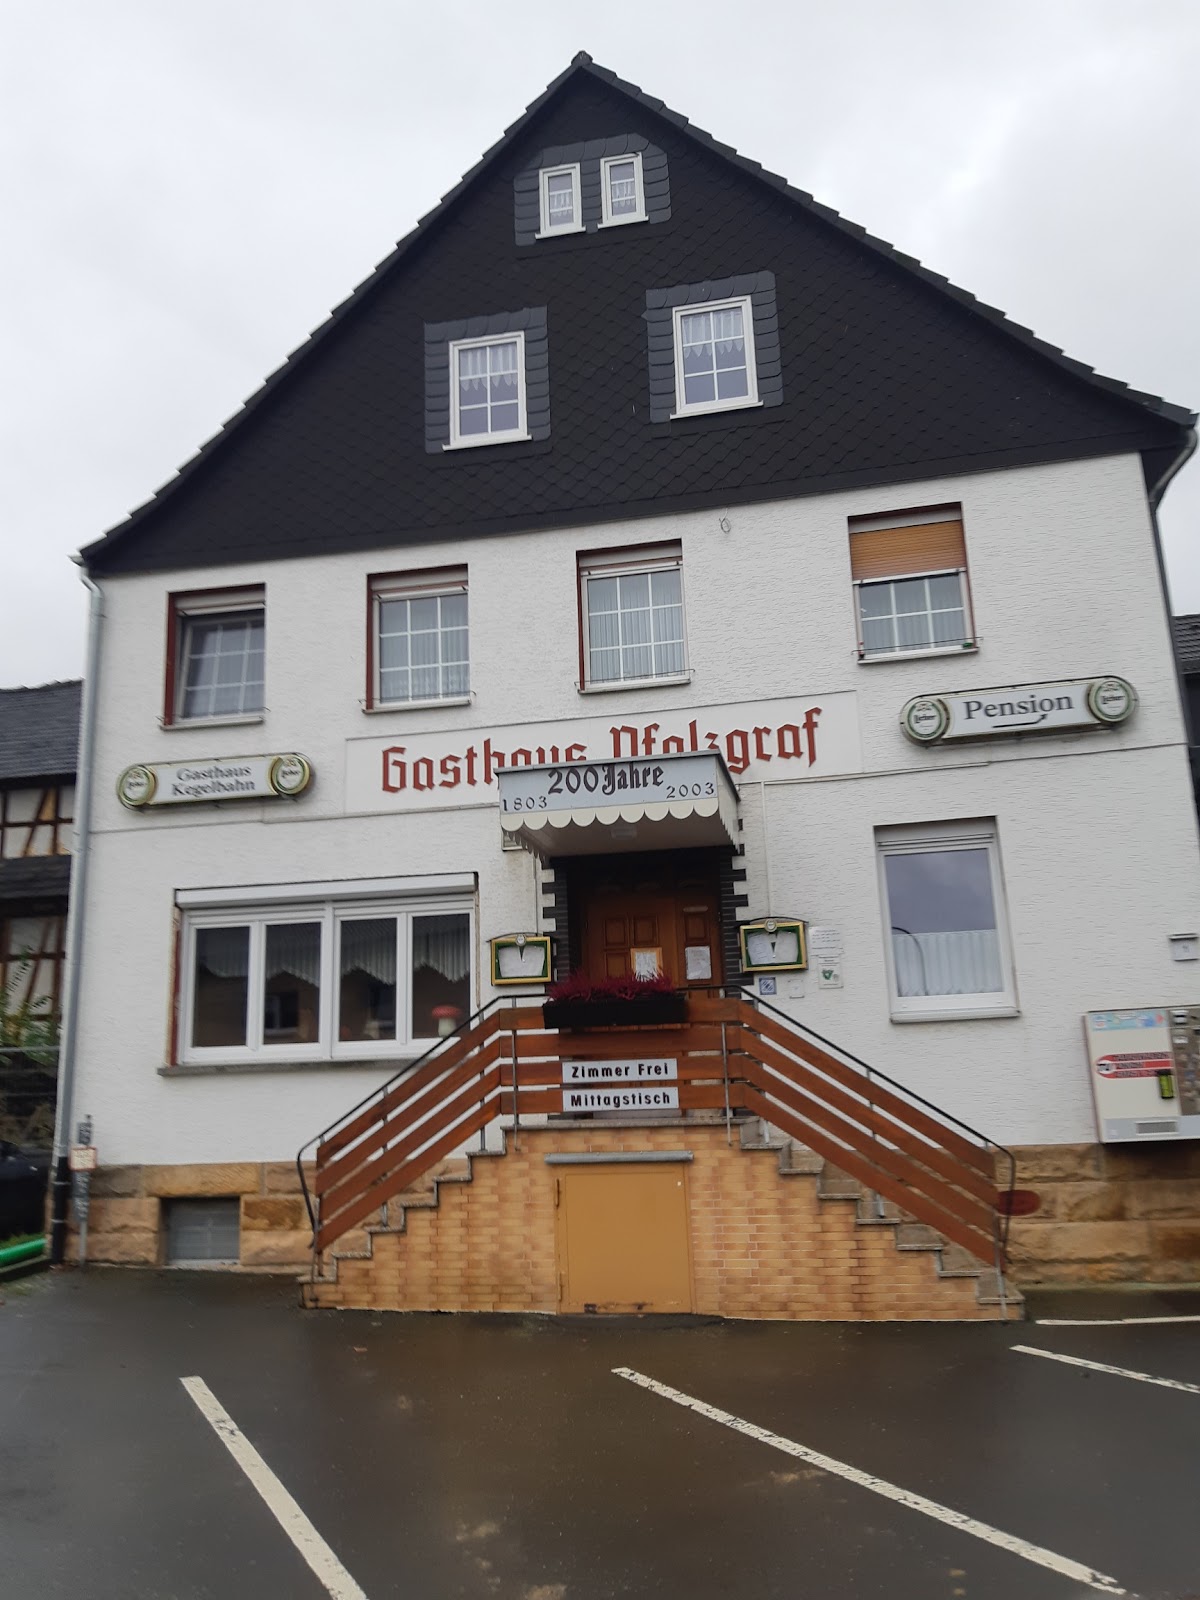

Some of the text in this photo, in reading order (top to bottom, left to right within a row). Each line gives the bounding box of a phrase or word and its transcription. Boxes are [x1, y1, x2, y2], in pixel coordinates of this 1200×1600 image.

[963, 694, 1074, 721] Pension
[176, 765, 252, 782] Gasthaus
[547, 762, 665, 796] 200 Jahre
[171, 779, 256, 797] Kegelbahn
[666, 782, 715, 799] 2003
[502, 796, 548, 812] 1803
[571, 1063, 669, 1078] Zimmer Frei
[570, 1092, 671, 1108] Mittagstisch
